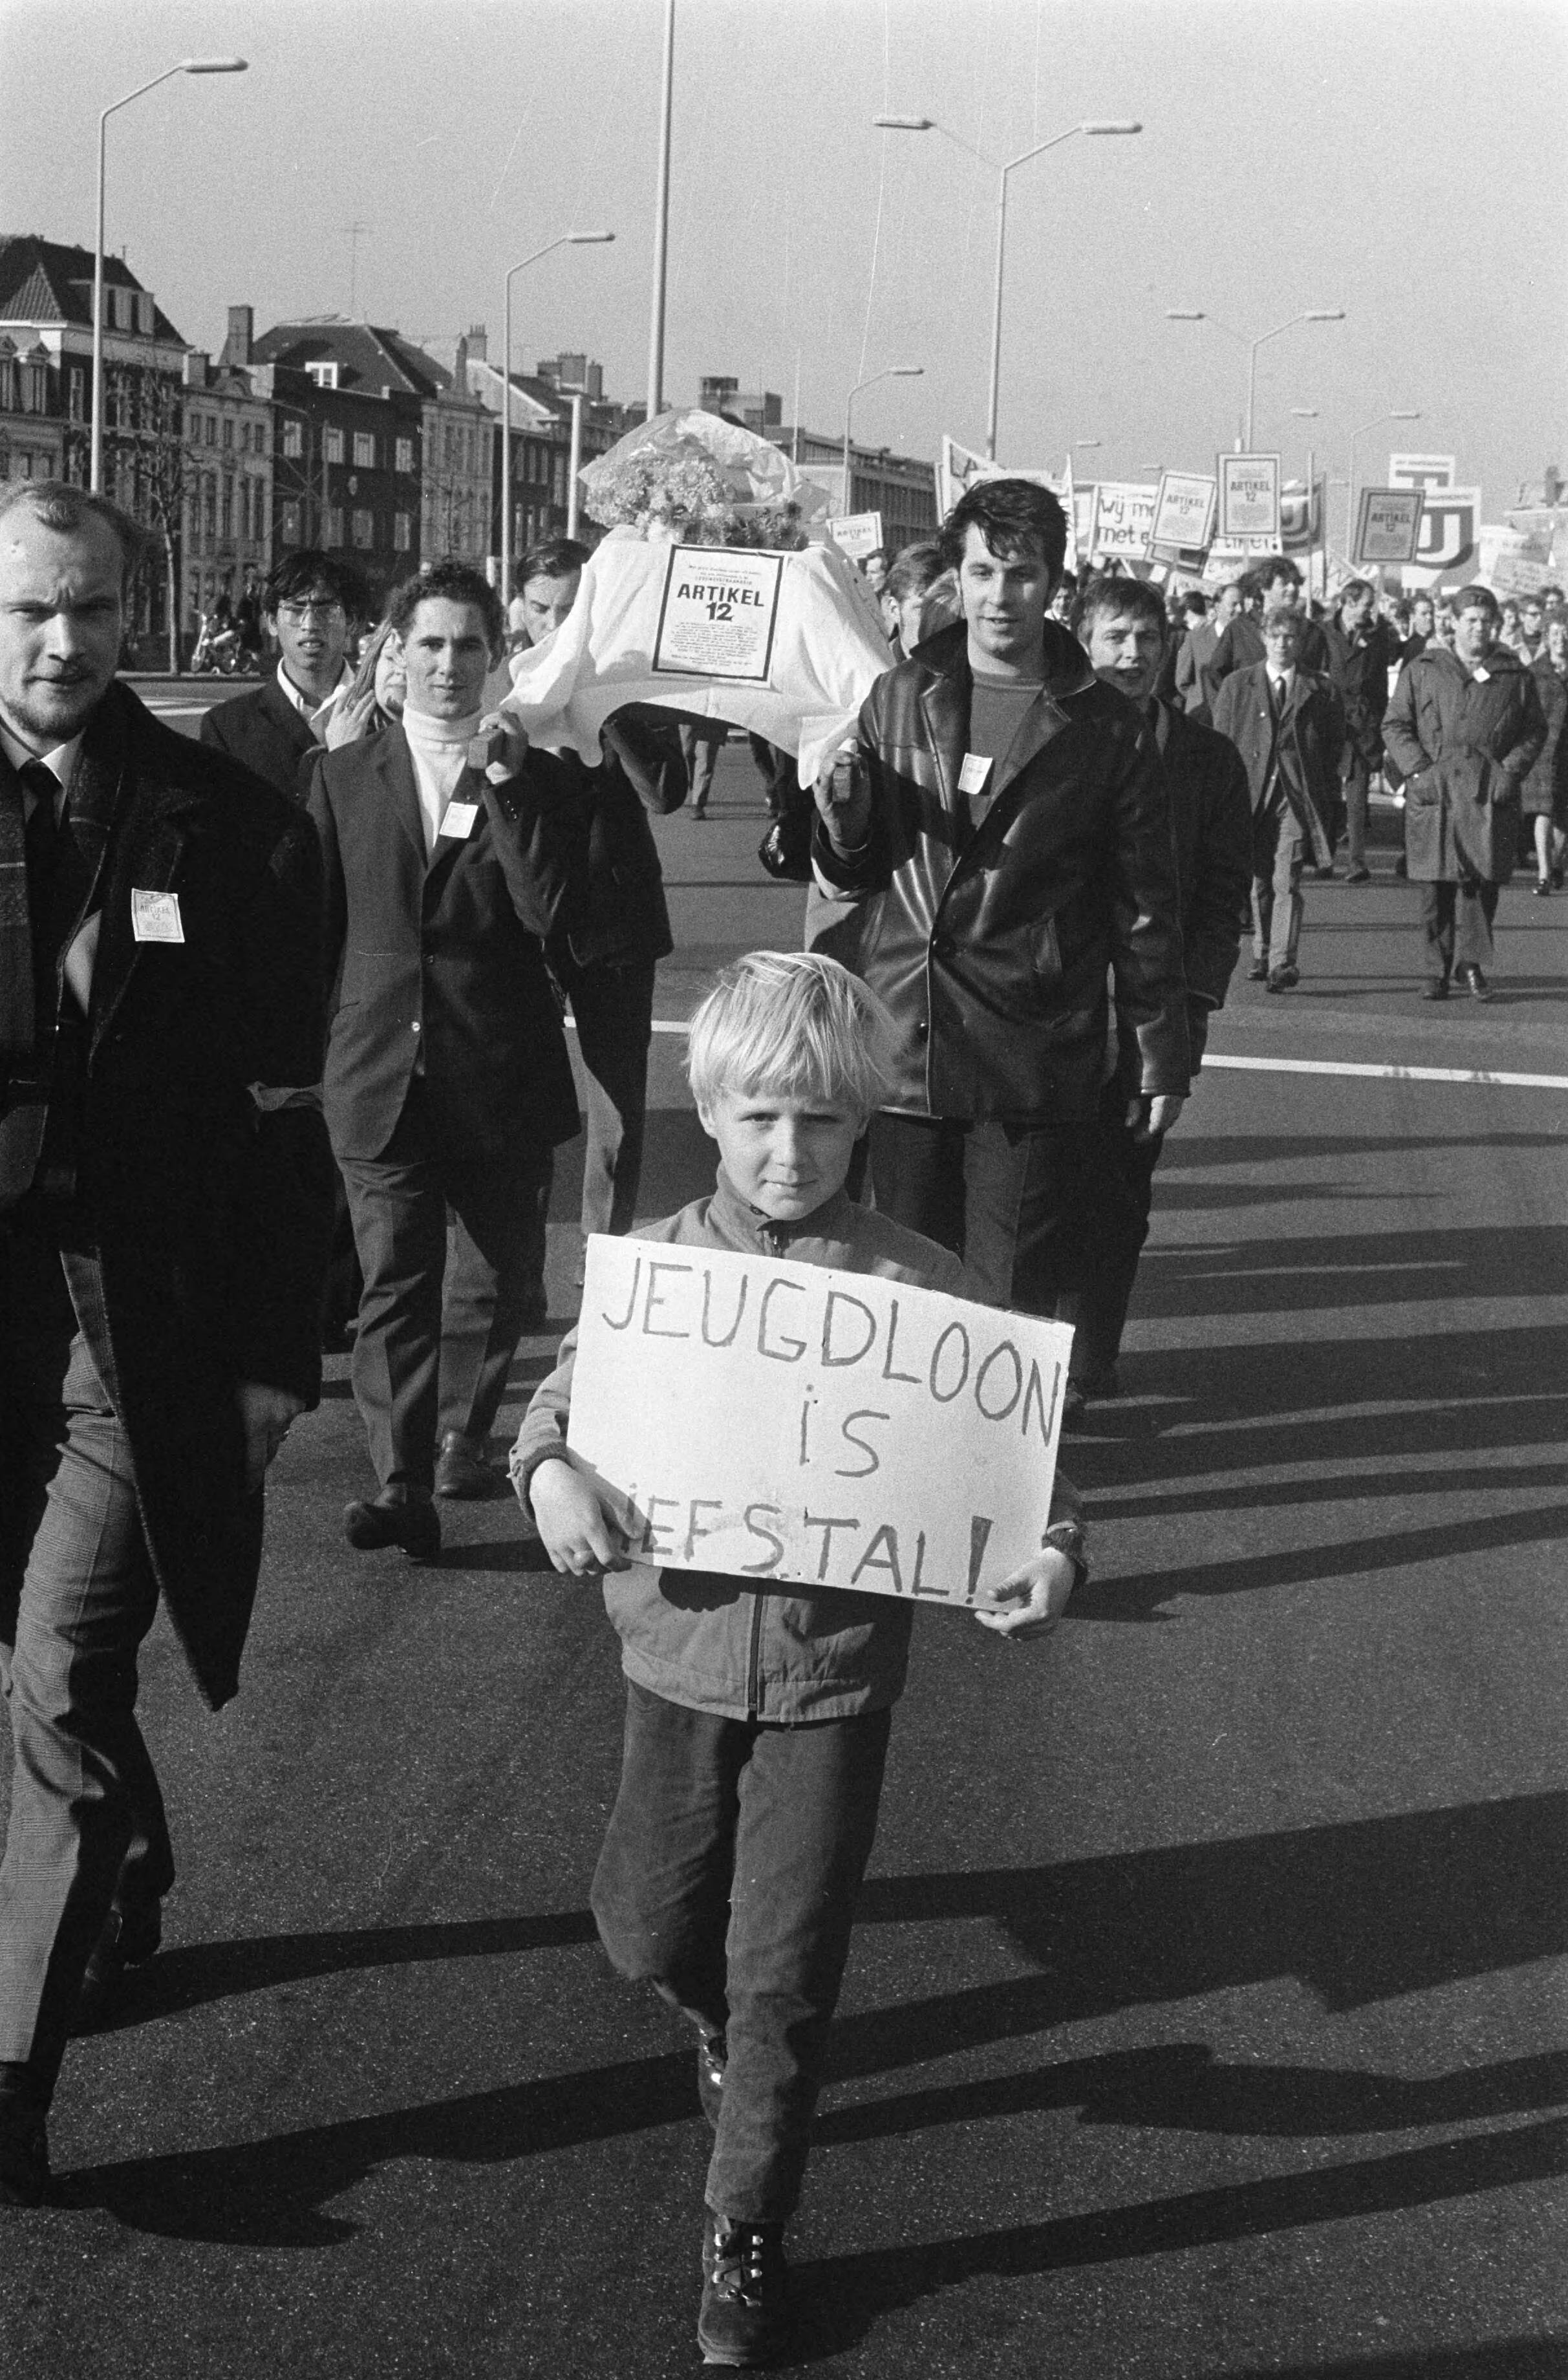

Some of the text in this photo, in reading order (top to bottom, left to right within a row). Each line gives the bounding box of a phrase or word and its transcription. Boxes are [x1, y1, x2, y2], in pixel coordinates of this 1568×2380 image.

[677, 583, 765, 607] ARTIKEL
[706, 601, 735, 622] 12
[602, 1248, 1061, 1447] JEUGDLOON
